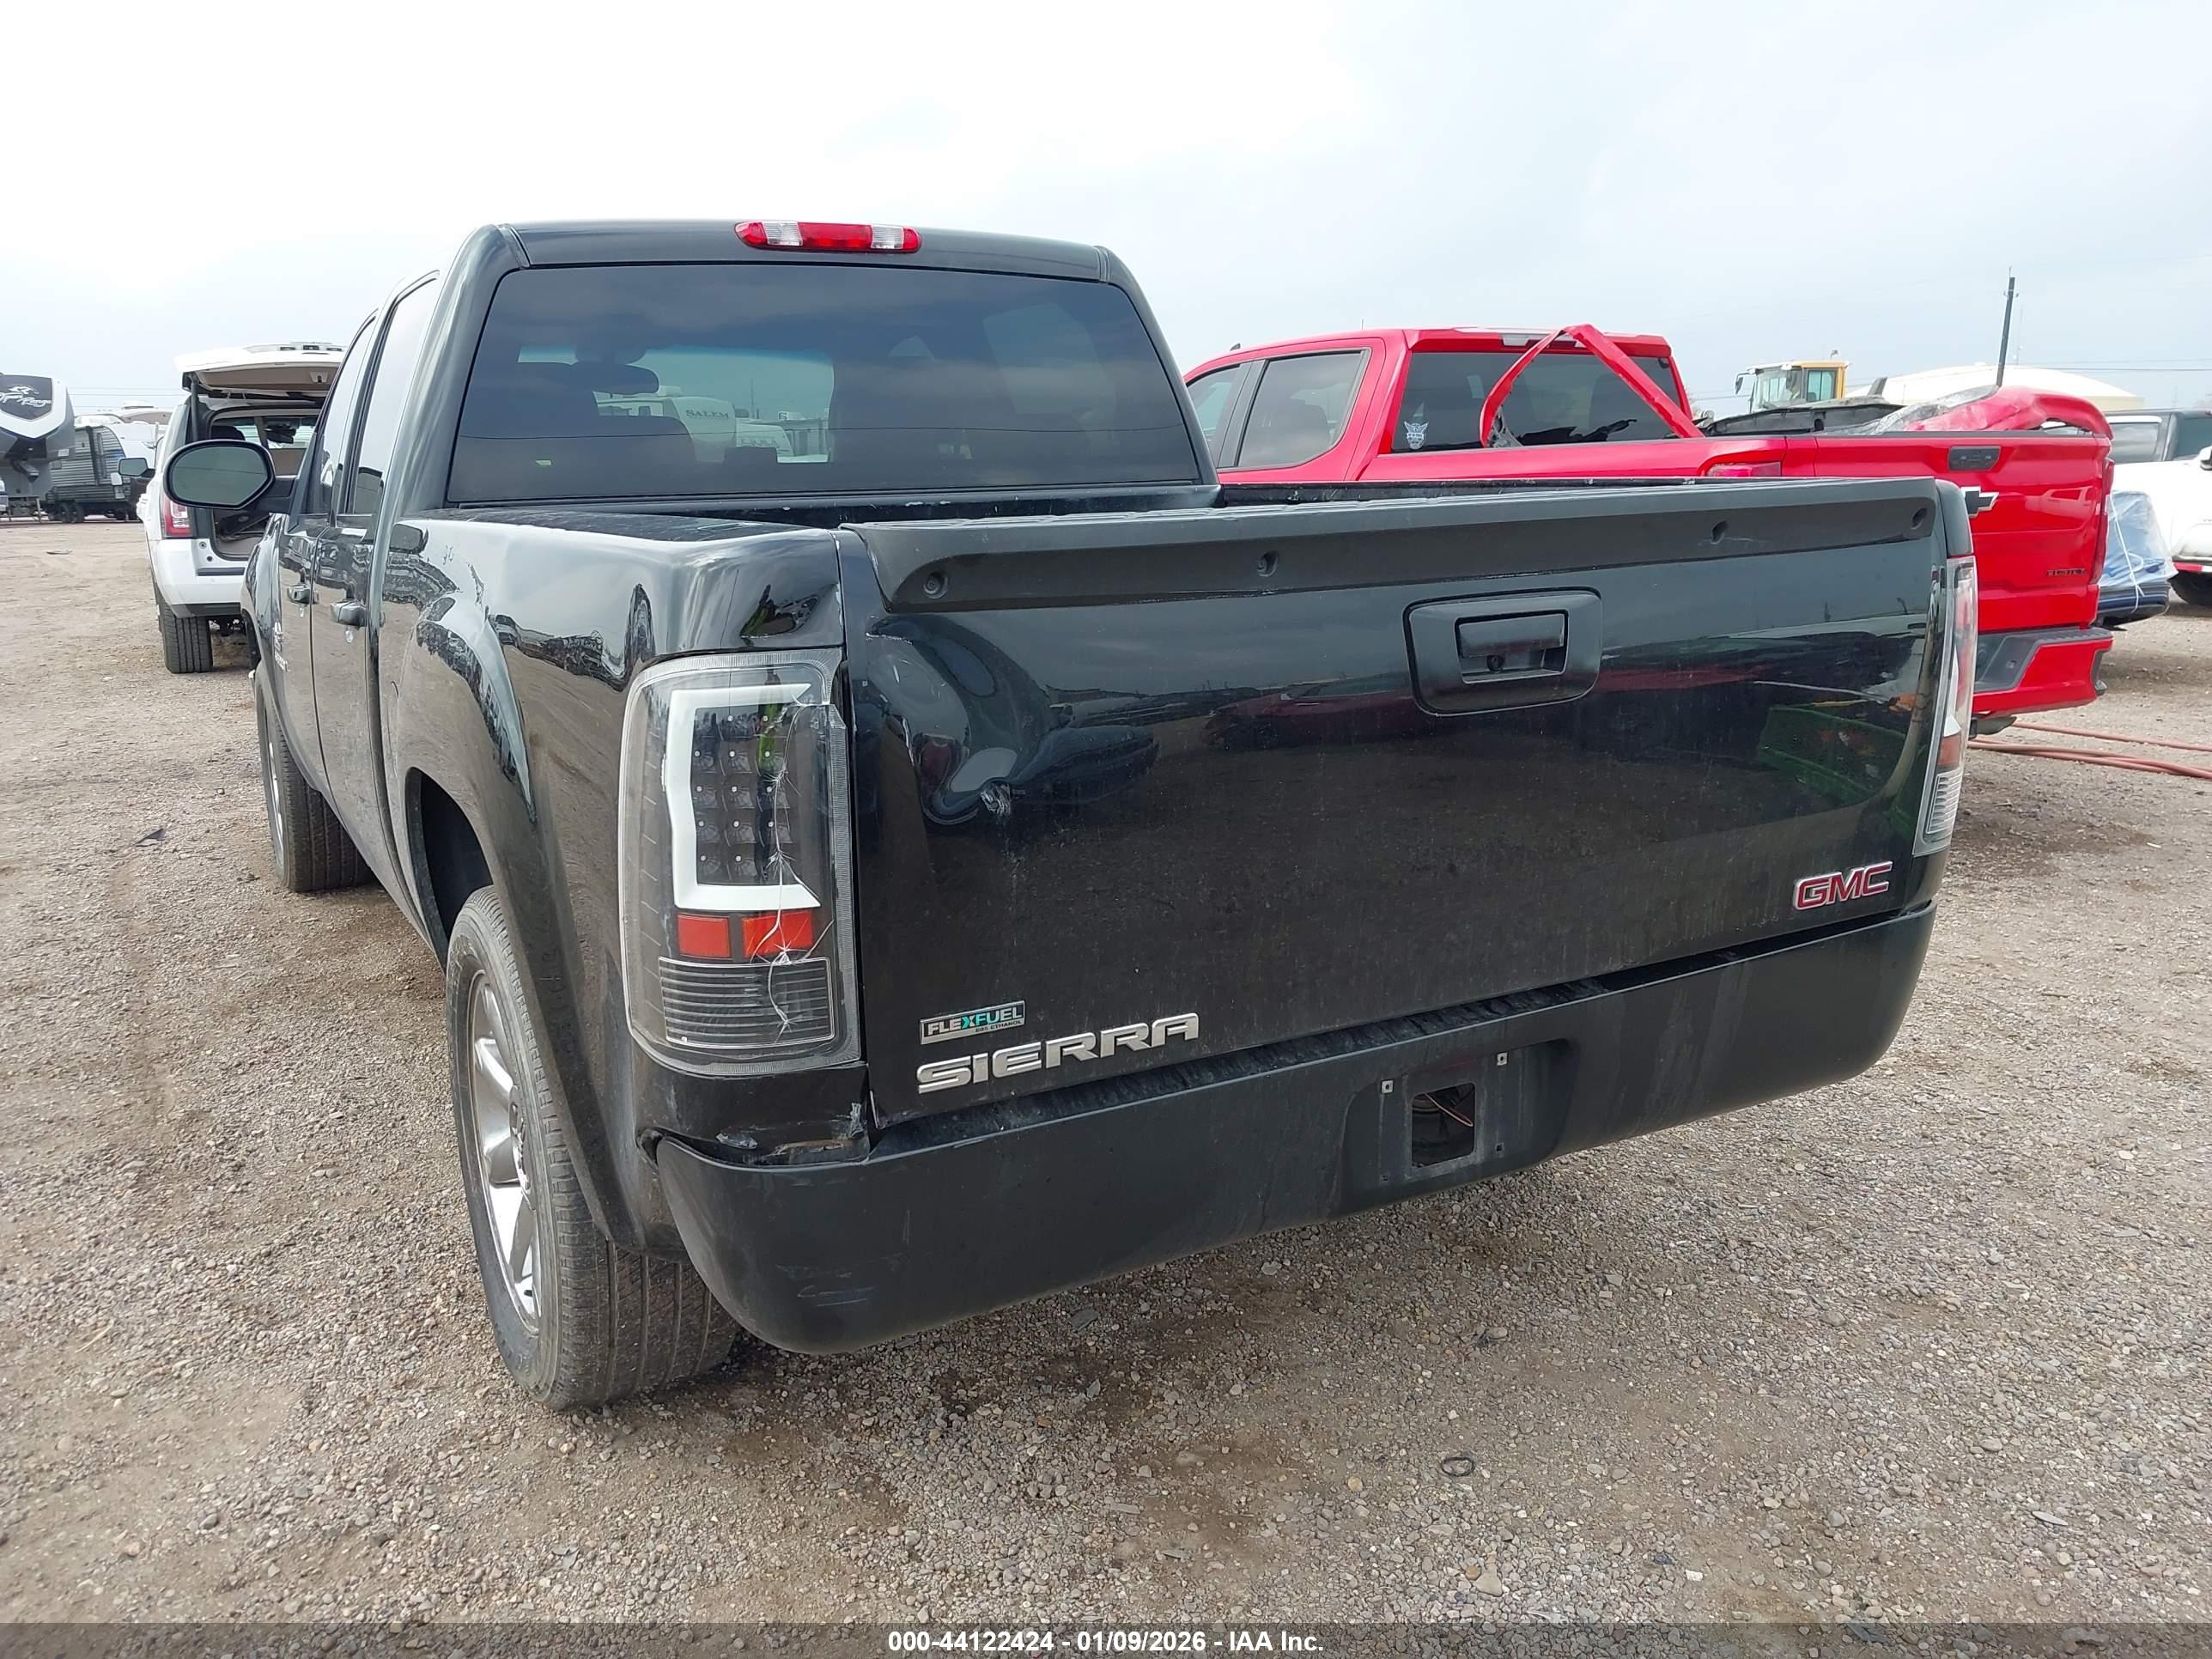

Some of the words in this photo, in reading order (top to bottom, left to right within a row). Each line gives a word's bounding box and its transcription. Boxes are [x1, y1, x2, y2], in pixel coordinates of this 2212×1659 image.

[1796, 861, 1893, 910] GMC
[927, 1006, 1022, 1036] FLEXFUEL
[990, 1020, 1022, 1030] ETHANOL
[916, 1012, 1200, 1094] SIERRA
